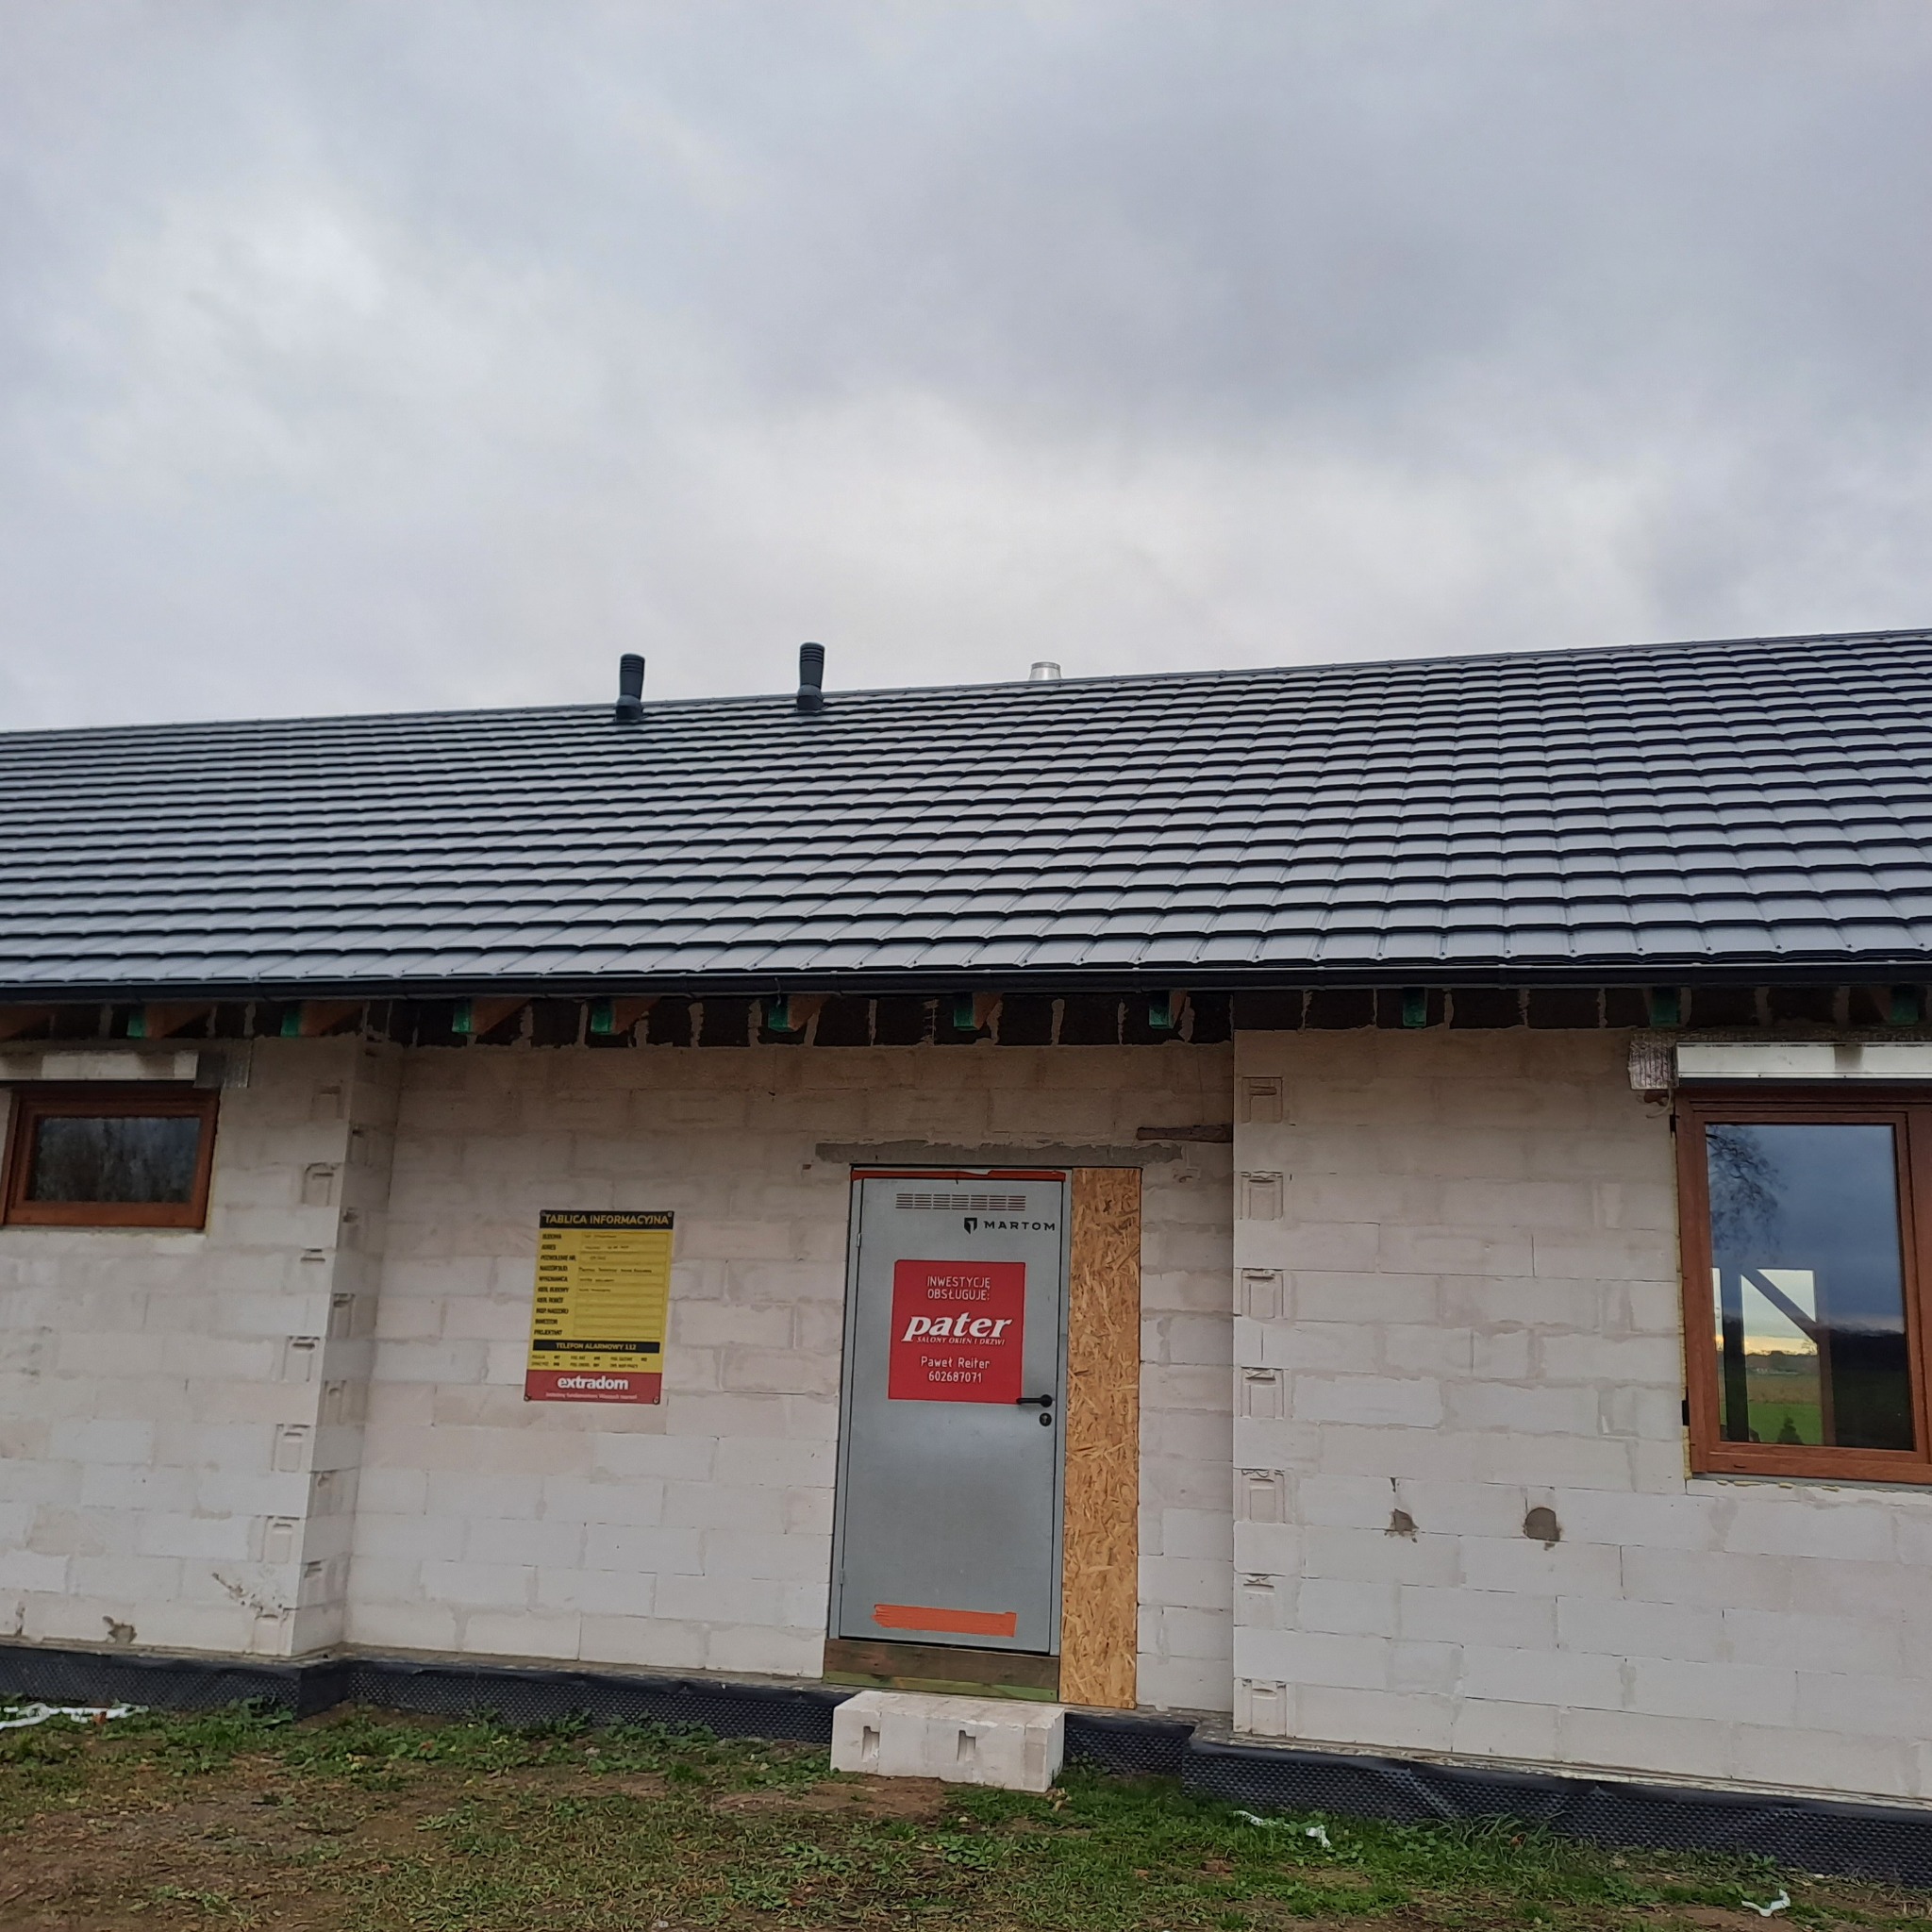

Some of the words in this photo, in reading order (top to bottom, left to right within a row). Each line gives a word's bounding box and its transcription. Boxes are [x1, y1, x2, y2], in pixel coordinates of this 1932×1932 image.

[545, 1213, 587, 1224] TABLICA
[590, 1214, 669, 1225] INFORMACYJNA
[984, 1221, 1056, 1232] MARTOM
[927, 1275, 991, 1289] INWESTYCJĘ
[927, 1289, 991, 1301] OBSŁUGUJE:
[901, 1312, 1012, 1342] pater
[916, 1336, 947, 1344] SALONY
[948, 1337, 973, 1345] OKIEN
[979, 1338, 1006, 1346] DRZWI
[921, 1356, 953, 1368] Paweł
[958, 1357, 991, 1368] Reiter
[558, 1375, 629, 1391] extradom
[928, 1371, 983, 1383] 602687071
